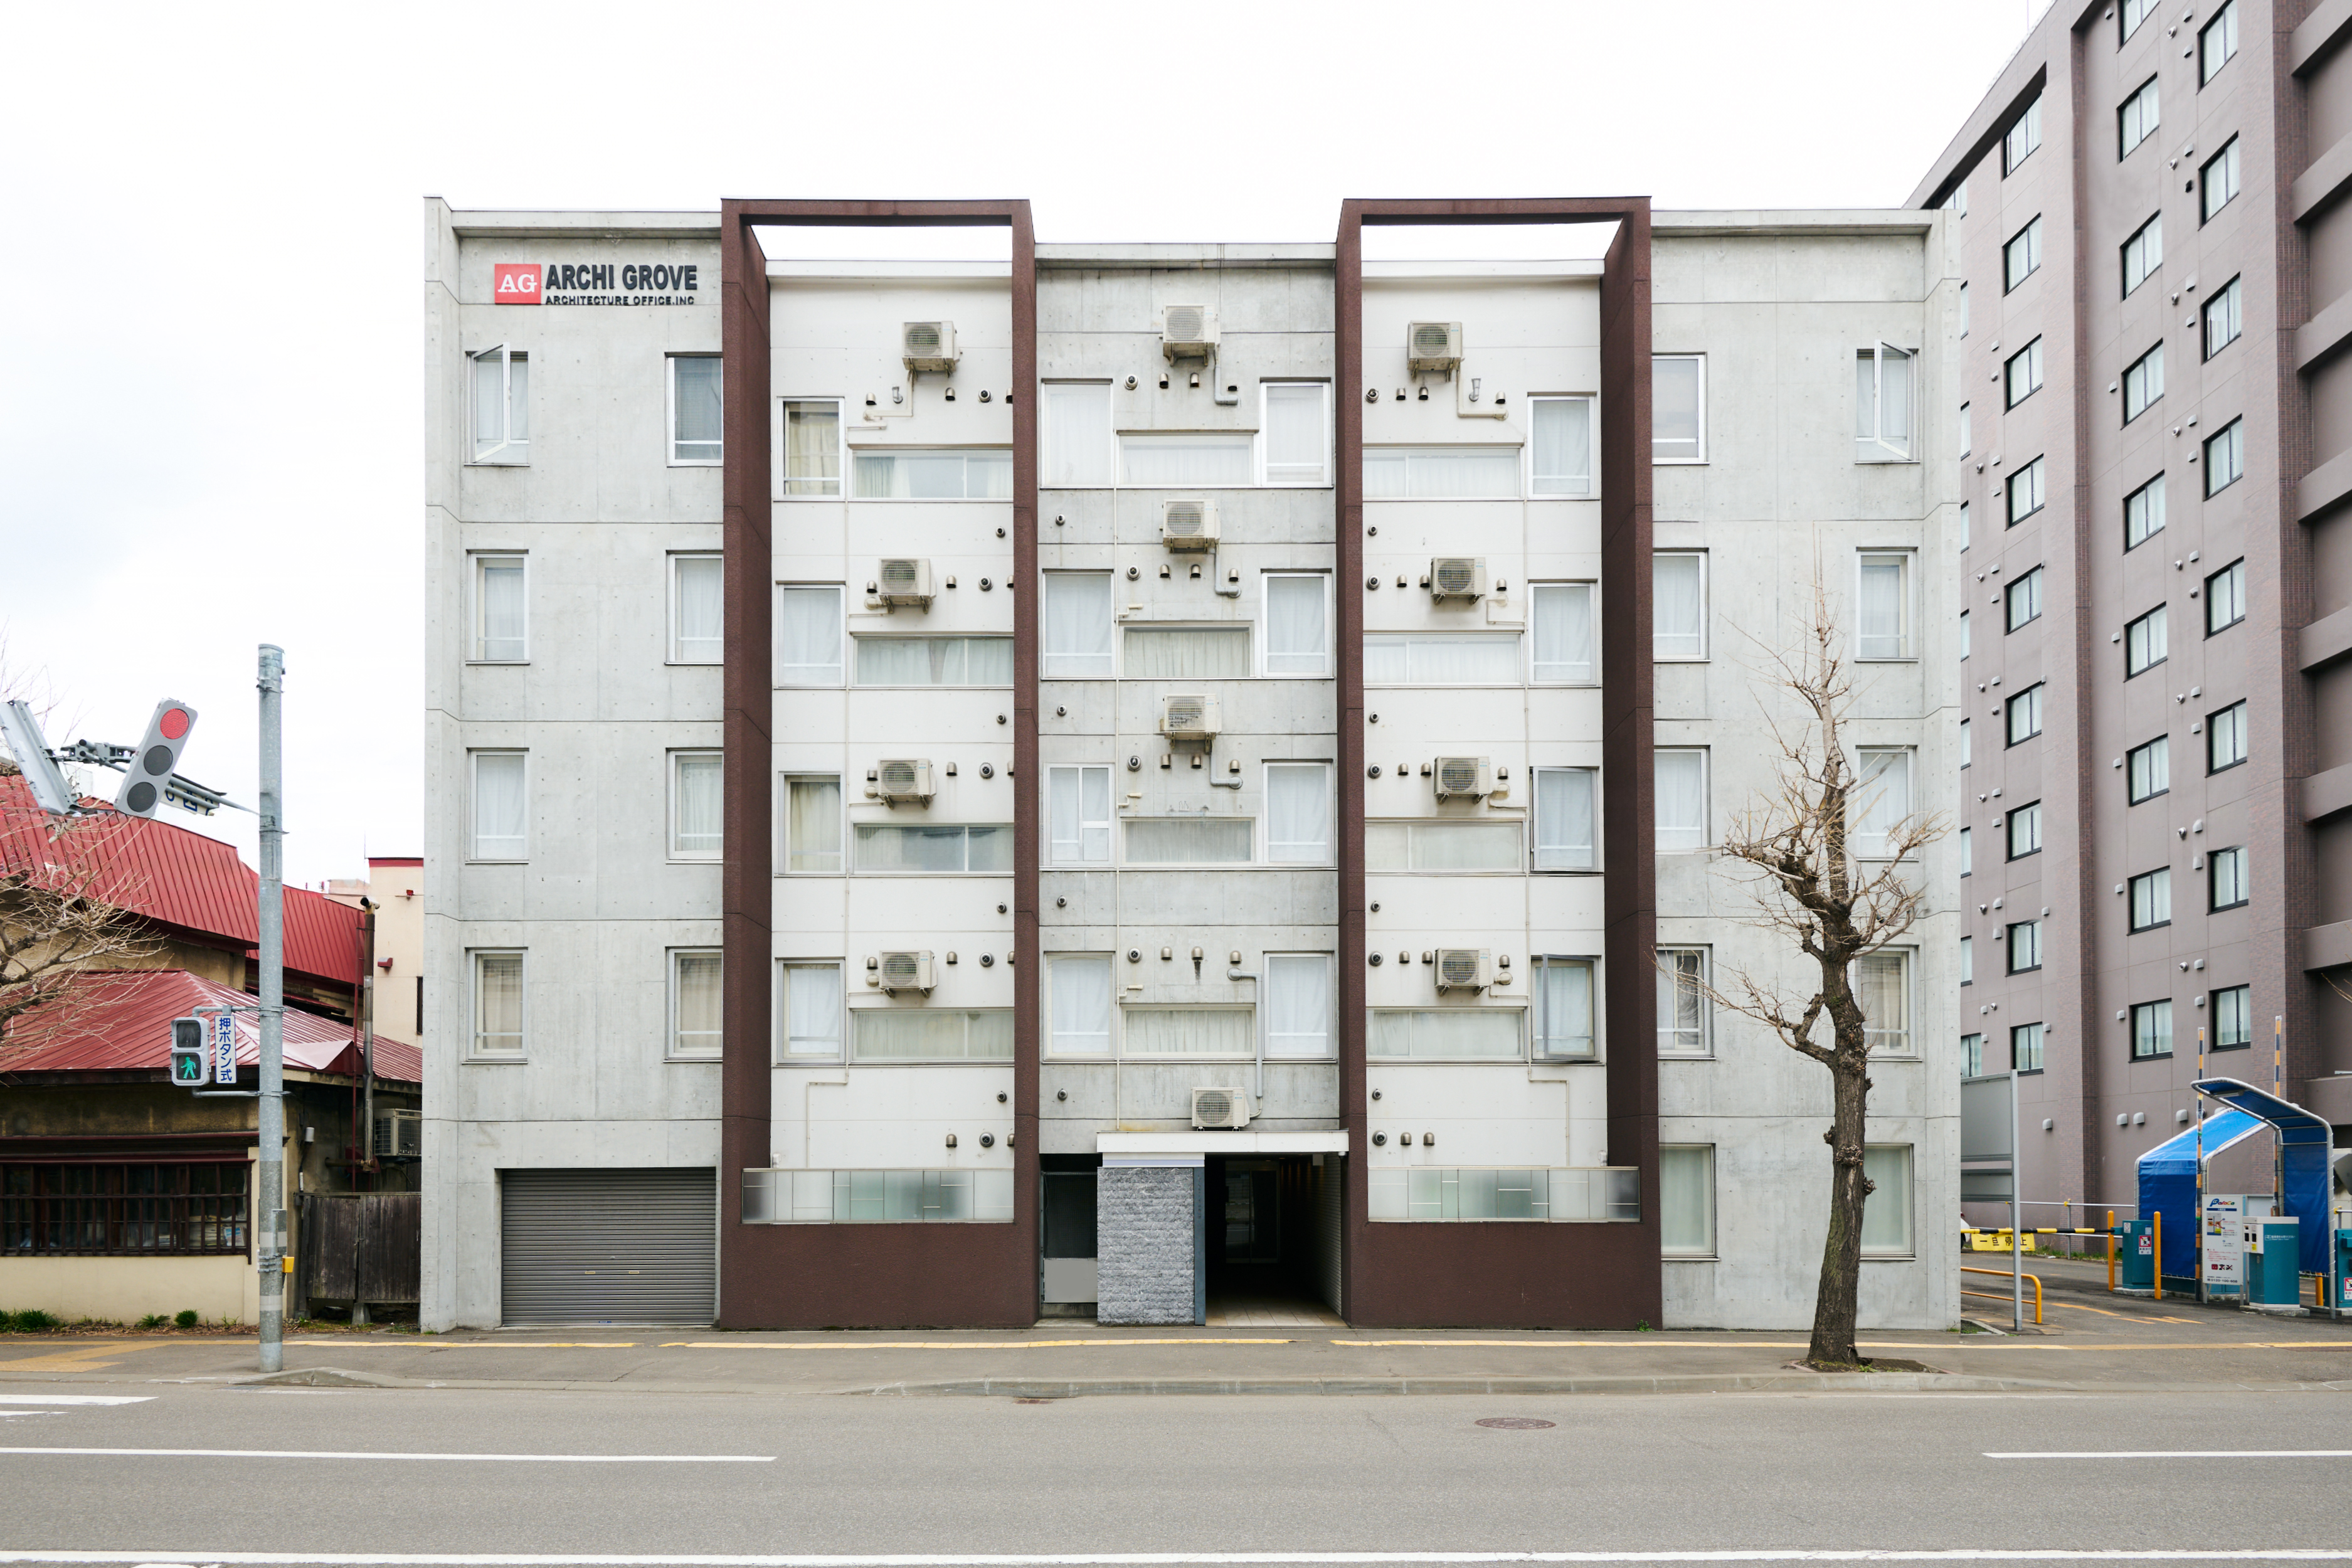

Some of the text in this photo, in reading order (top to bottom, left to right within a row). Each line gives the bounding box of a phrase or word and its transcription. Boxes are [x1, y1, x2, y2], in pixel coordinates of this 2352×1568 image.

[497, 274, 537, 292] AG
[545, 264, 697, 290] ARCHI GROVE
[546, 296, 629, 305] ARCHITECTURE
[219, 1017, 232, 1081] 押ボタン式
